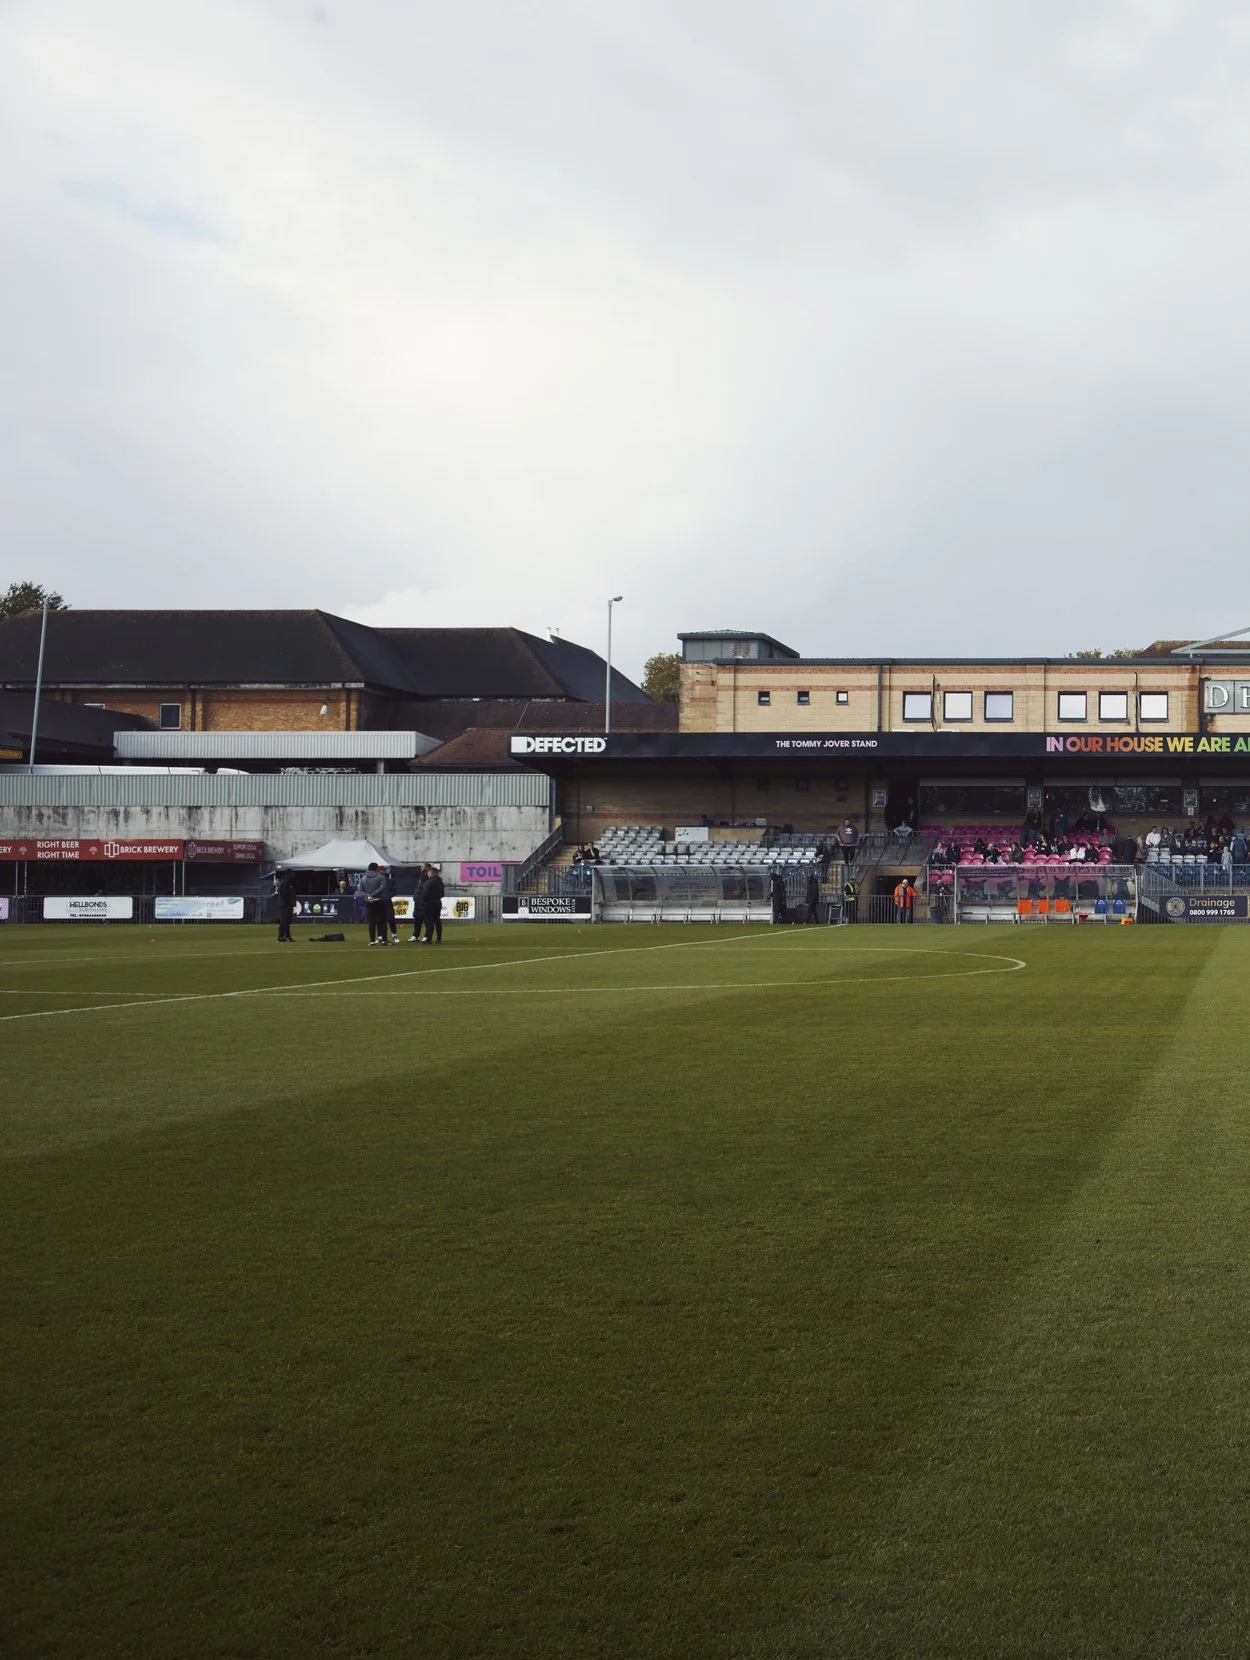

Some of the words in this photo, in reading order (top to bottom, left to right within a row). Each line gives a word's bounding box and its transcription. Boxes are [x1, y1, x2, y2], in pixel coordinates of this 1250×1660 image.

[511, 736, 606, 753] DEFECTED
[775, 740, 790, 748] THE
[791, 740, 822, 748] TOMMY
[823, 740, 850, 748] JOVER
[851, 740, 878, 748] STAND
[1046, 736, 1064, 752] IN
[1066, 736, 1104, 752] OUR
[1106, 736, 1164, 752] HOUSE
[1166, 736, 1194, 752] WE
[1196, 736, 1230, 752] ARE
[37, 841, 60, 849] RIGHT
[61, 841, 80, 849] BEER
[120, 846, 142, 854] BRICK
[144, 846, 178, 854] BREWERY
[37, 851, 60, 859] RIGHT
[61, 851, 80, 859] TIME
[206, 901, 224, 909] reef
[531, 898, 571, 906] BESPOKE
[1189, 898, 1236, 908] Drainage
[456, 902, 468, 912] BIG
